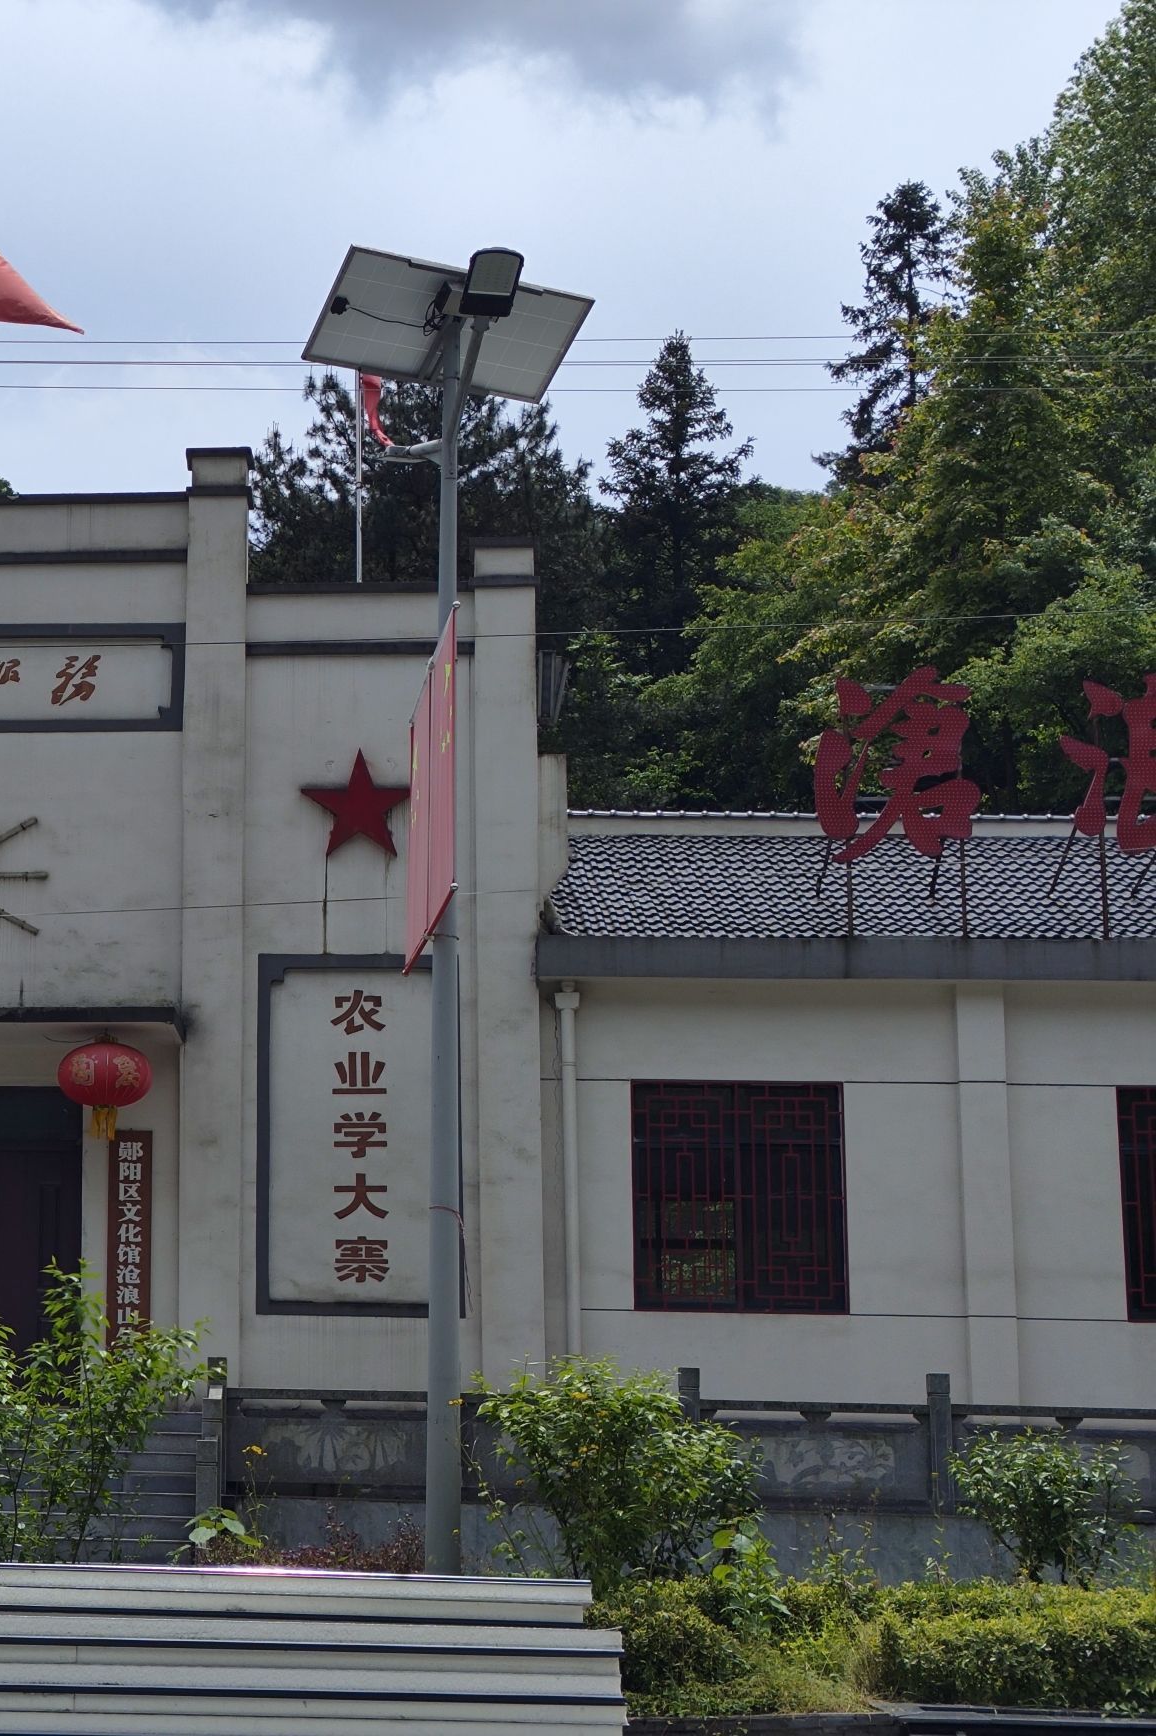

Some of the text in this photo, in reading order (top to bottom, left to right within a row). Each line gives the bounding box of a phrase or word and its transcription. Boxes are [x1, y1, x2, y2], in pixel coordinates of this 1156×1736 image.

[330, 989, 390, 1283] 农业学大寨
